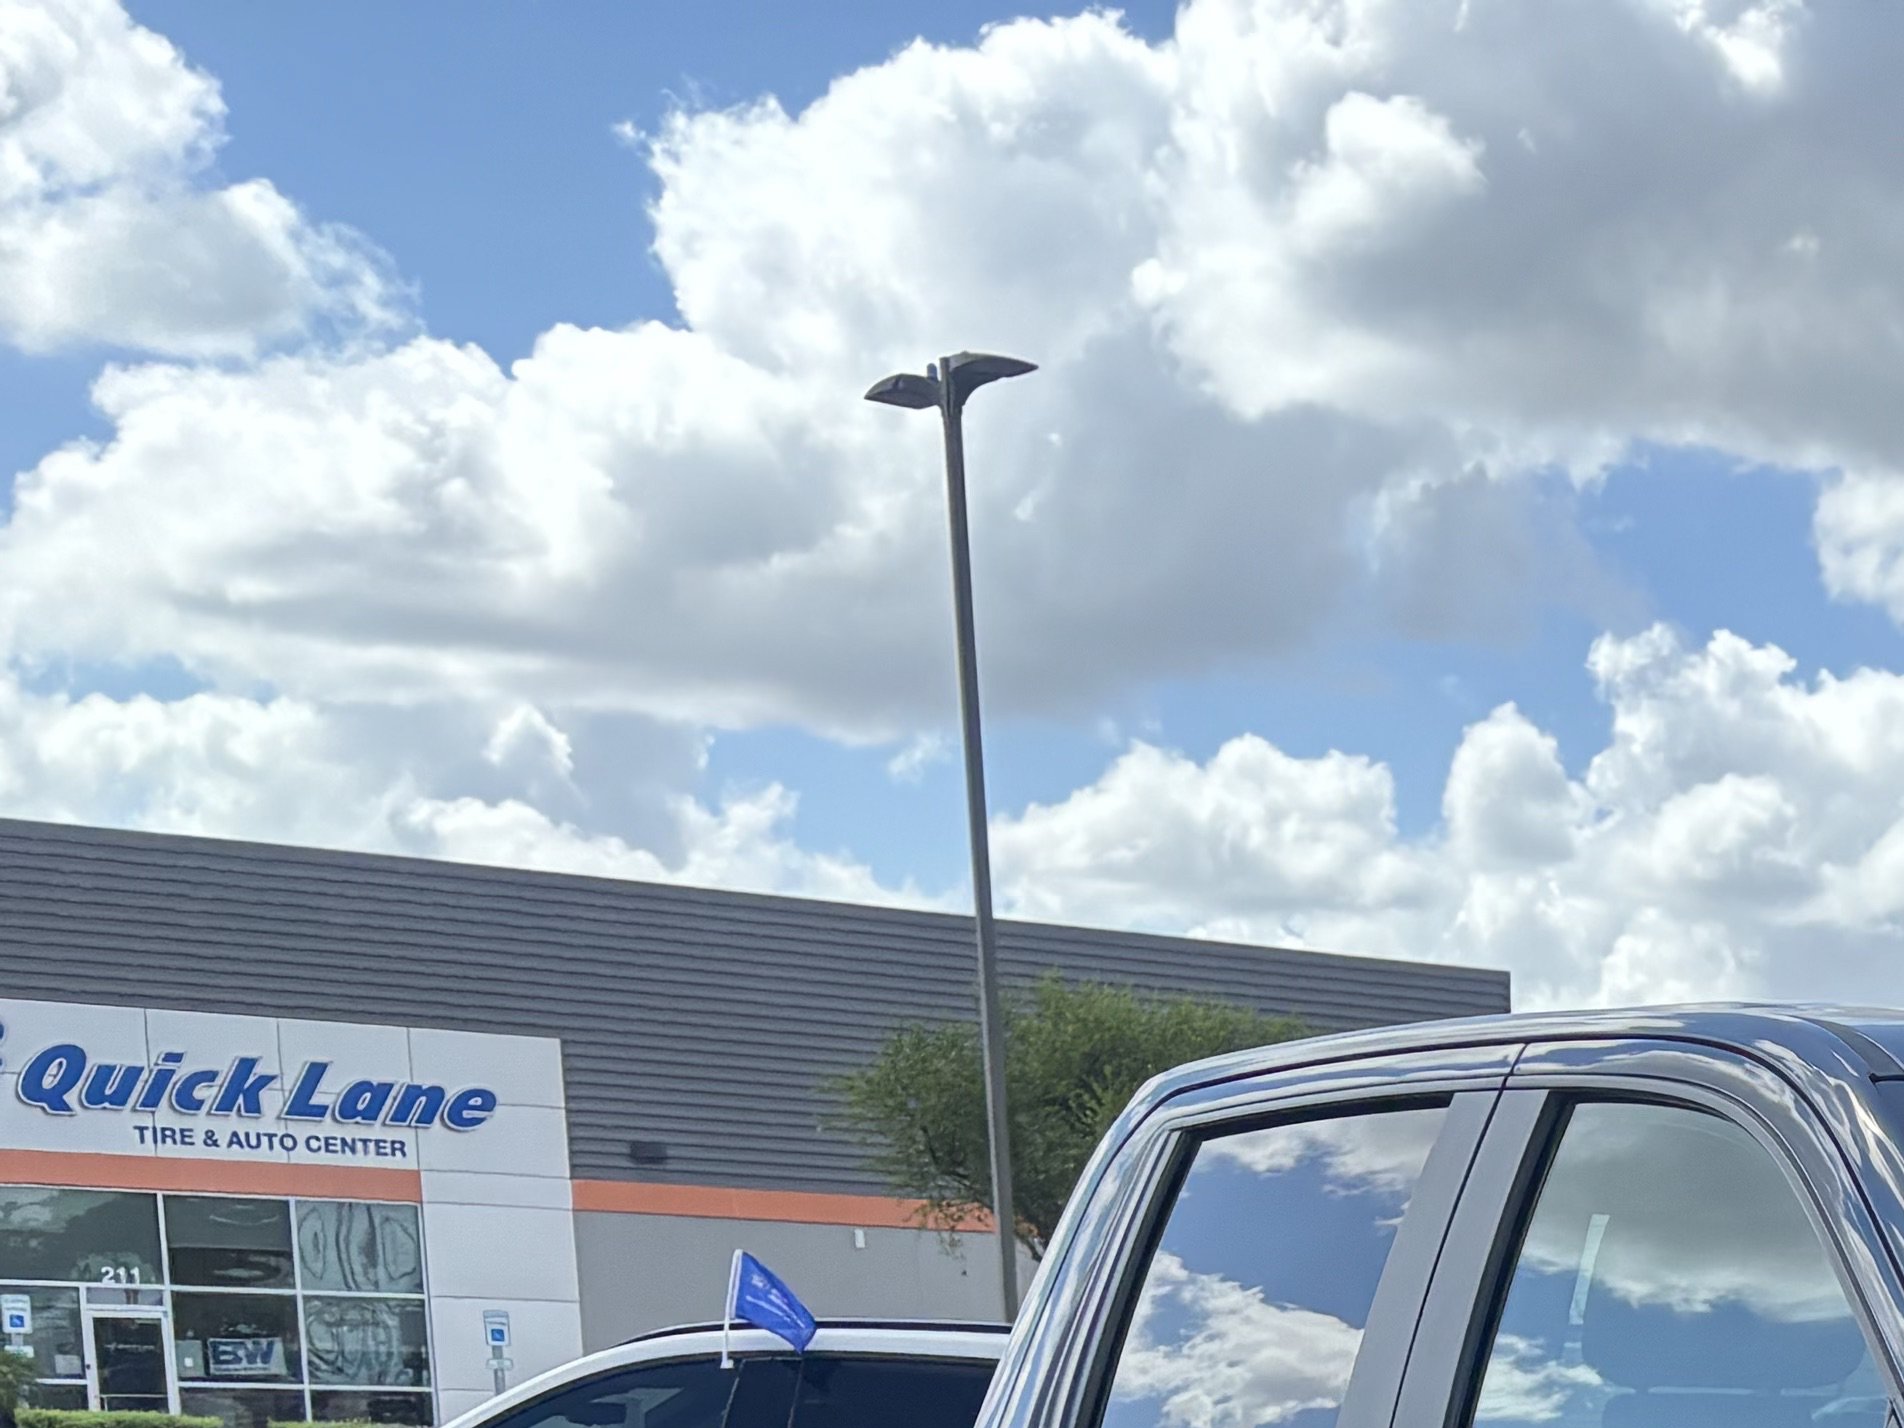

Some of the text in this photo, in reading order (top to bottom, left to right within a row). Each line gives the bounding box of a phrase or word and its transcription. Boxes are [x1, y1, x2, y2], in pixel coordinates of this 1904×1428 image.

[17, 1043, 498, 1132] Quick Lane
[133, 1126, 407, 1158] TIRE & AUTO CENTER
[100, 1266, 141, 1284] 211
